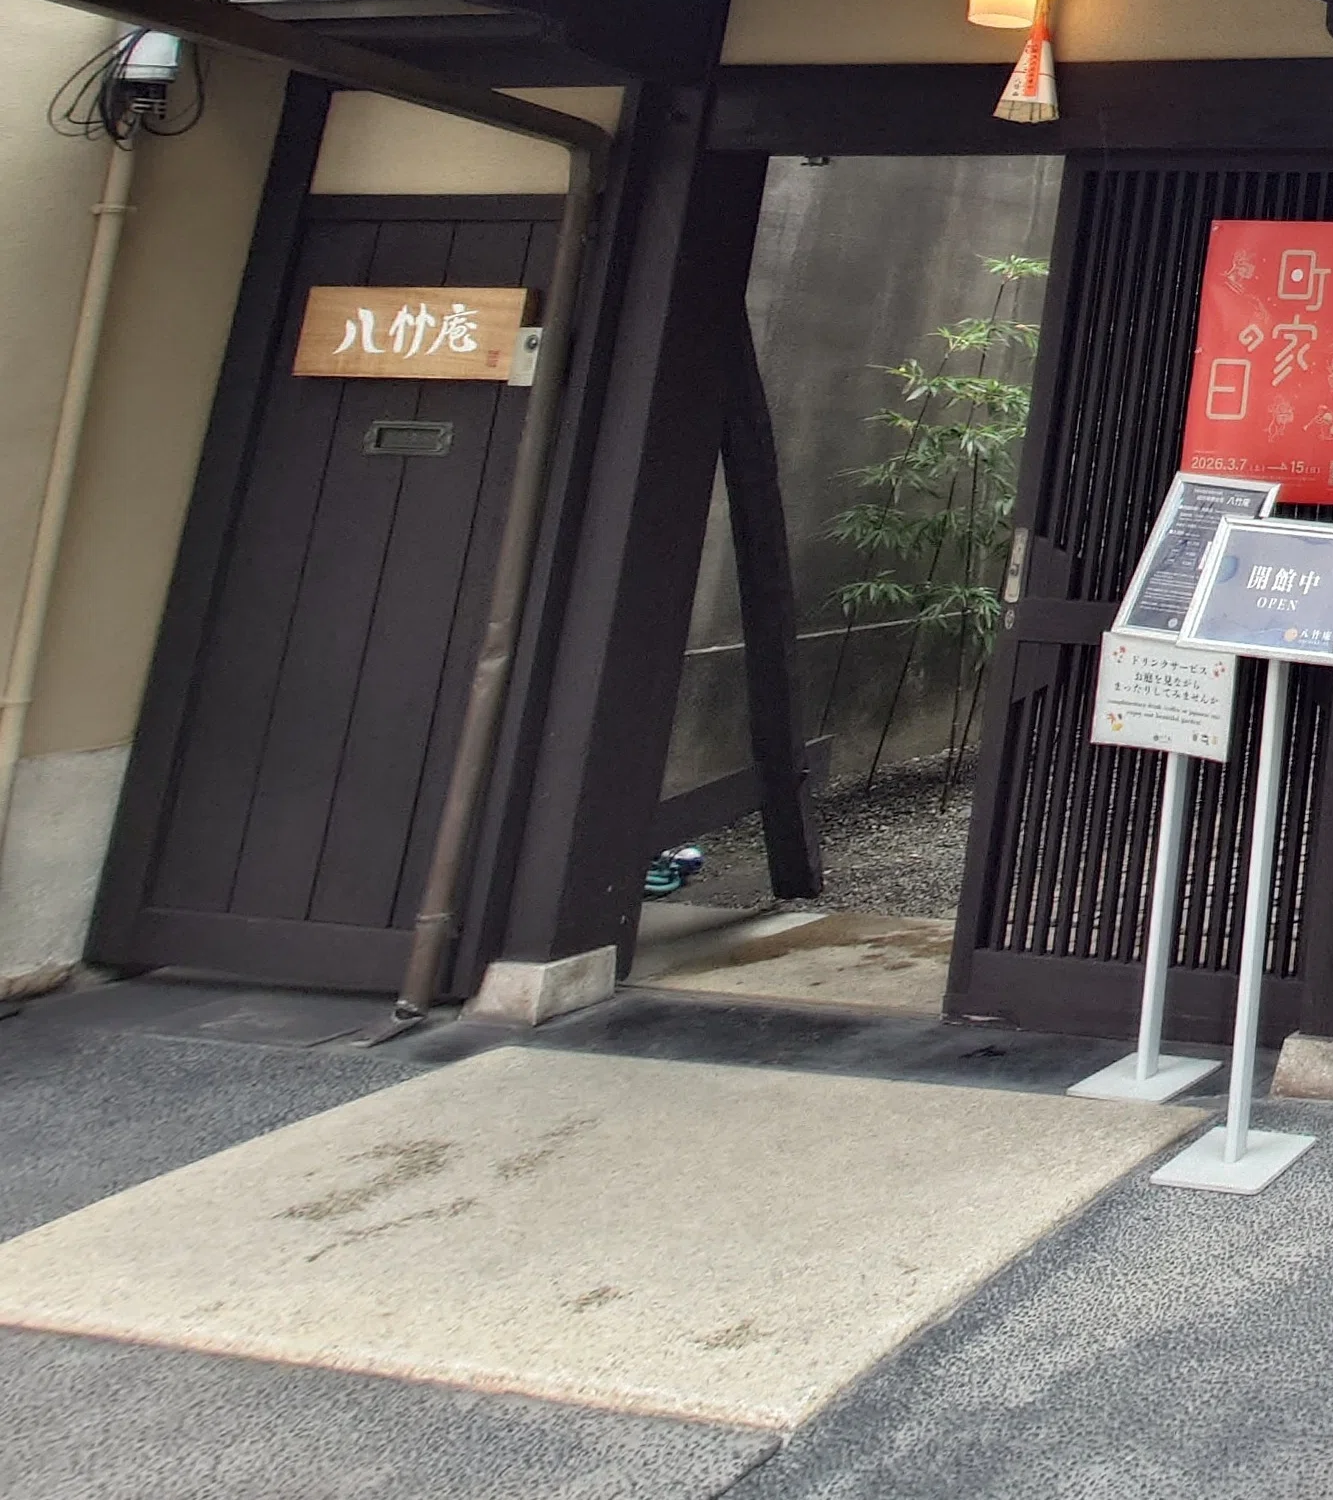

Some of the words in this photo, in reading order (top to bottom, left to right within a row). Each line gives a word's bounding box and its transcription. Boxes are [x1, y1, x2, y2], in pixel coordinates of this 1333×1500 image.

[332, 303, 480, 360] 八竹庵
[1247, 565, 1321, 595] 開館中
[1256, 596, 1299, 611] OPEN
[1131, 655, 1208, 675] ドリンクサービス
[1134, 672, 1201, 690] お庭を見ながら
[1113, 682, 1220, 705] まったりしてみませんか
